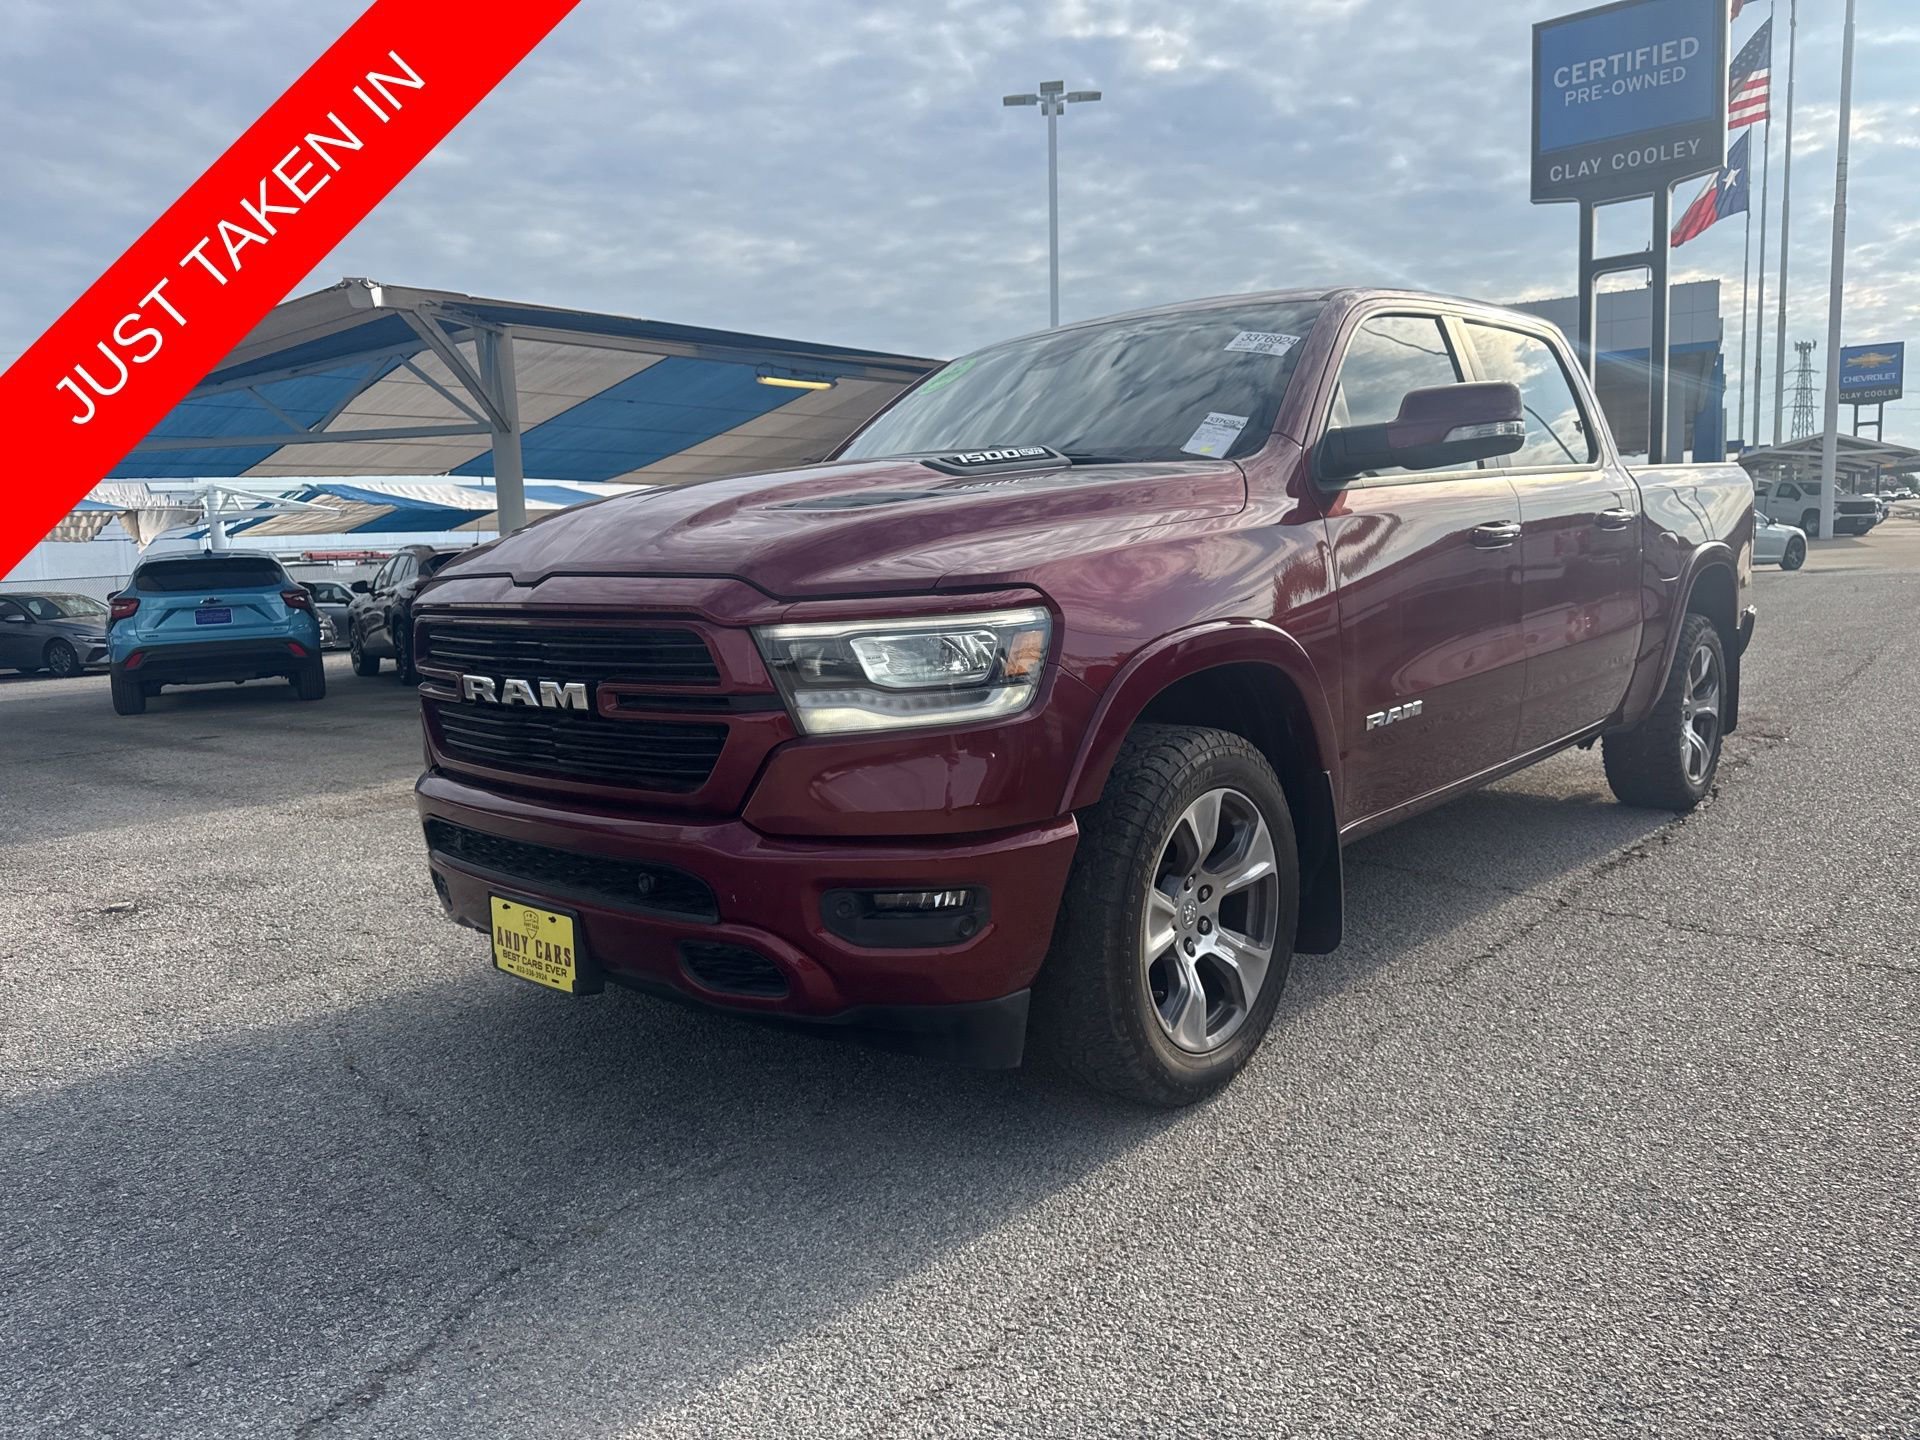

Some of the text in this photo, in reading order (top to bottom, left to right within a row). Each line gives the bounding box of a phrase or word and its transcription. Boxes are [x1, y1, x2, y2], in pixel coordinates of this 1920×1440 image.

[1553, 36, 1699, 88] CERTIFIED
[1565, 66, 1686, 107] PRE-OWNED
[1550, 138, 1700, 182] CLAY COOLEY
[1840, 389, 1900, 400] CLAY COOLEY
[1843, 372, 1897, 384] CHEVROLET
[953, 449, 1021, 464] 1500
[462, 674, 589, 710] RAM
[1366, 700, 1423, 731] RAM
[496, 926, 572, 967] ANDY CARS
[503, 949, 567, 978] BEST CARS EVER
